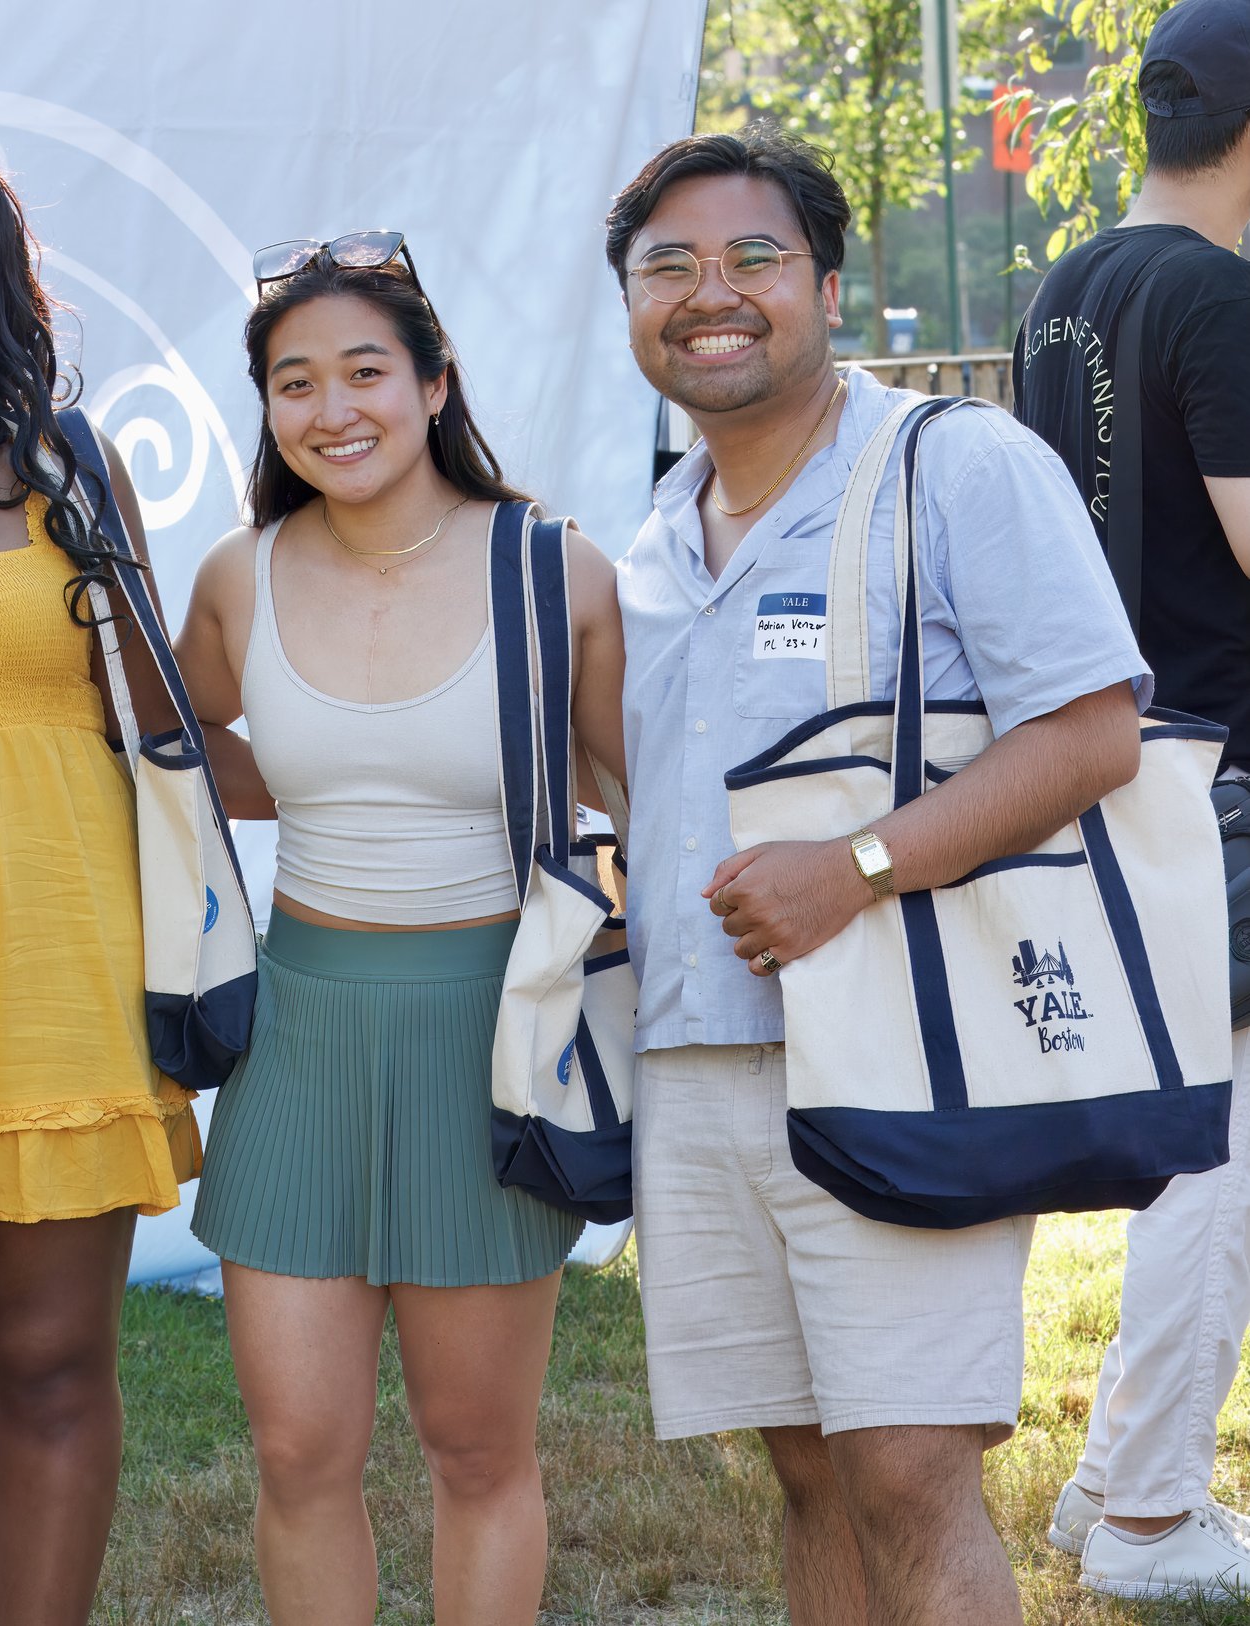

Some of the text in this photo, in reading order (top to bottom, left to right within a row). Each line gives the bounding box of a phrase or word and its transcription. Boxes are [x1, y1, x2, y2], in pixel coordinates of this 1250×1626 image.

[1025, 316, 1090, 370] SCIENE
[782, 598, 809, 607] YALE
[758, 620, 785, 630] Adrian
[1014, 991, 1088, 1027] YALE
[1037, 1026, 1086, 1054] Boston
